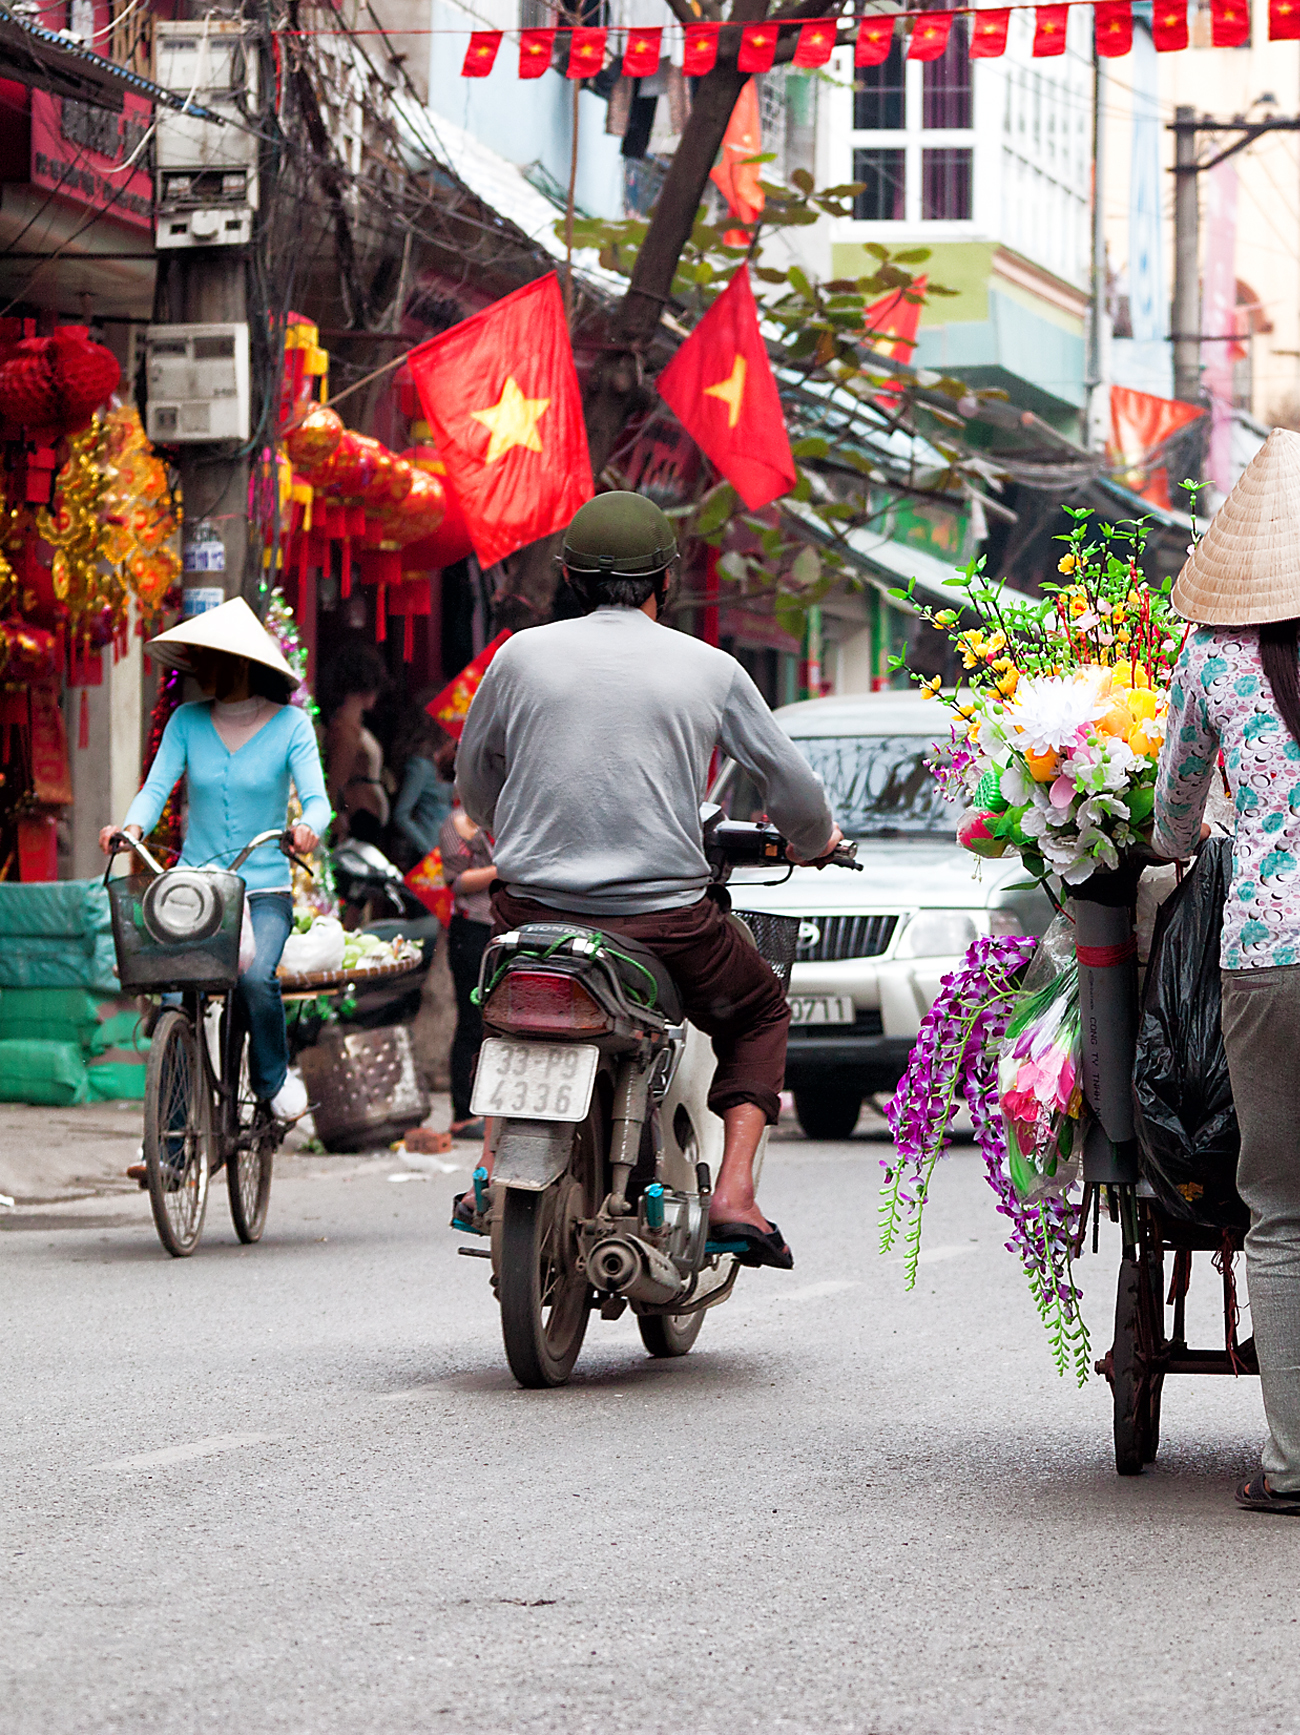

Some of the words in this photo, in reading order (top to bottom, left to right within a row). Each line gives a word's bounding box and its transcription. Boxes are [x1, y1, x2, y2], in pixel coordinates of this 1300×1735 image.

[527, 925, 588, 938] HONDA
[790, 998, 845, 1022] 0711
[489, 1080, 572, 1114] 4336
[1092, 1073, 1101, 1102] TNHH
